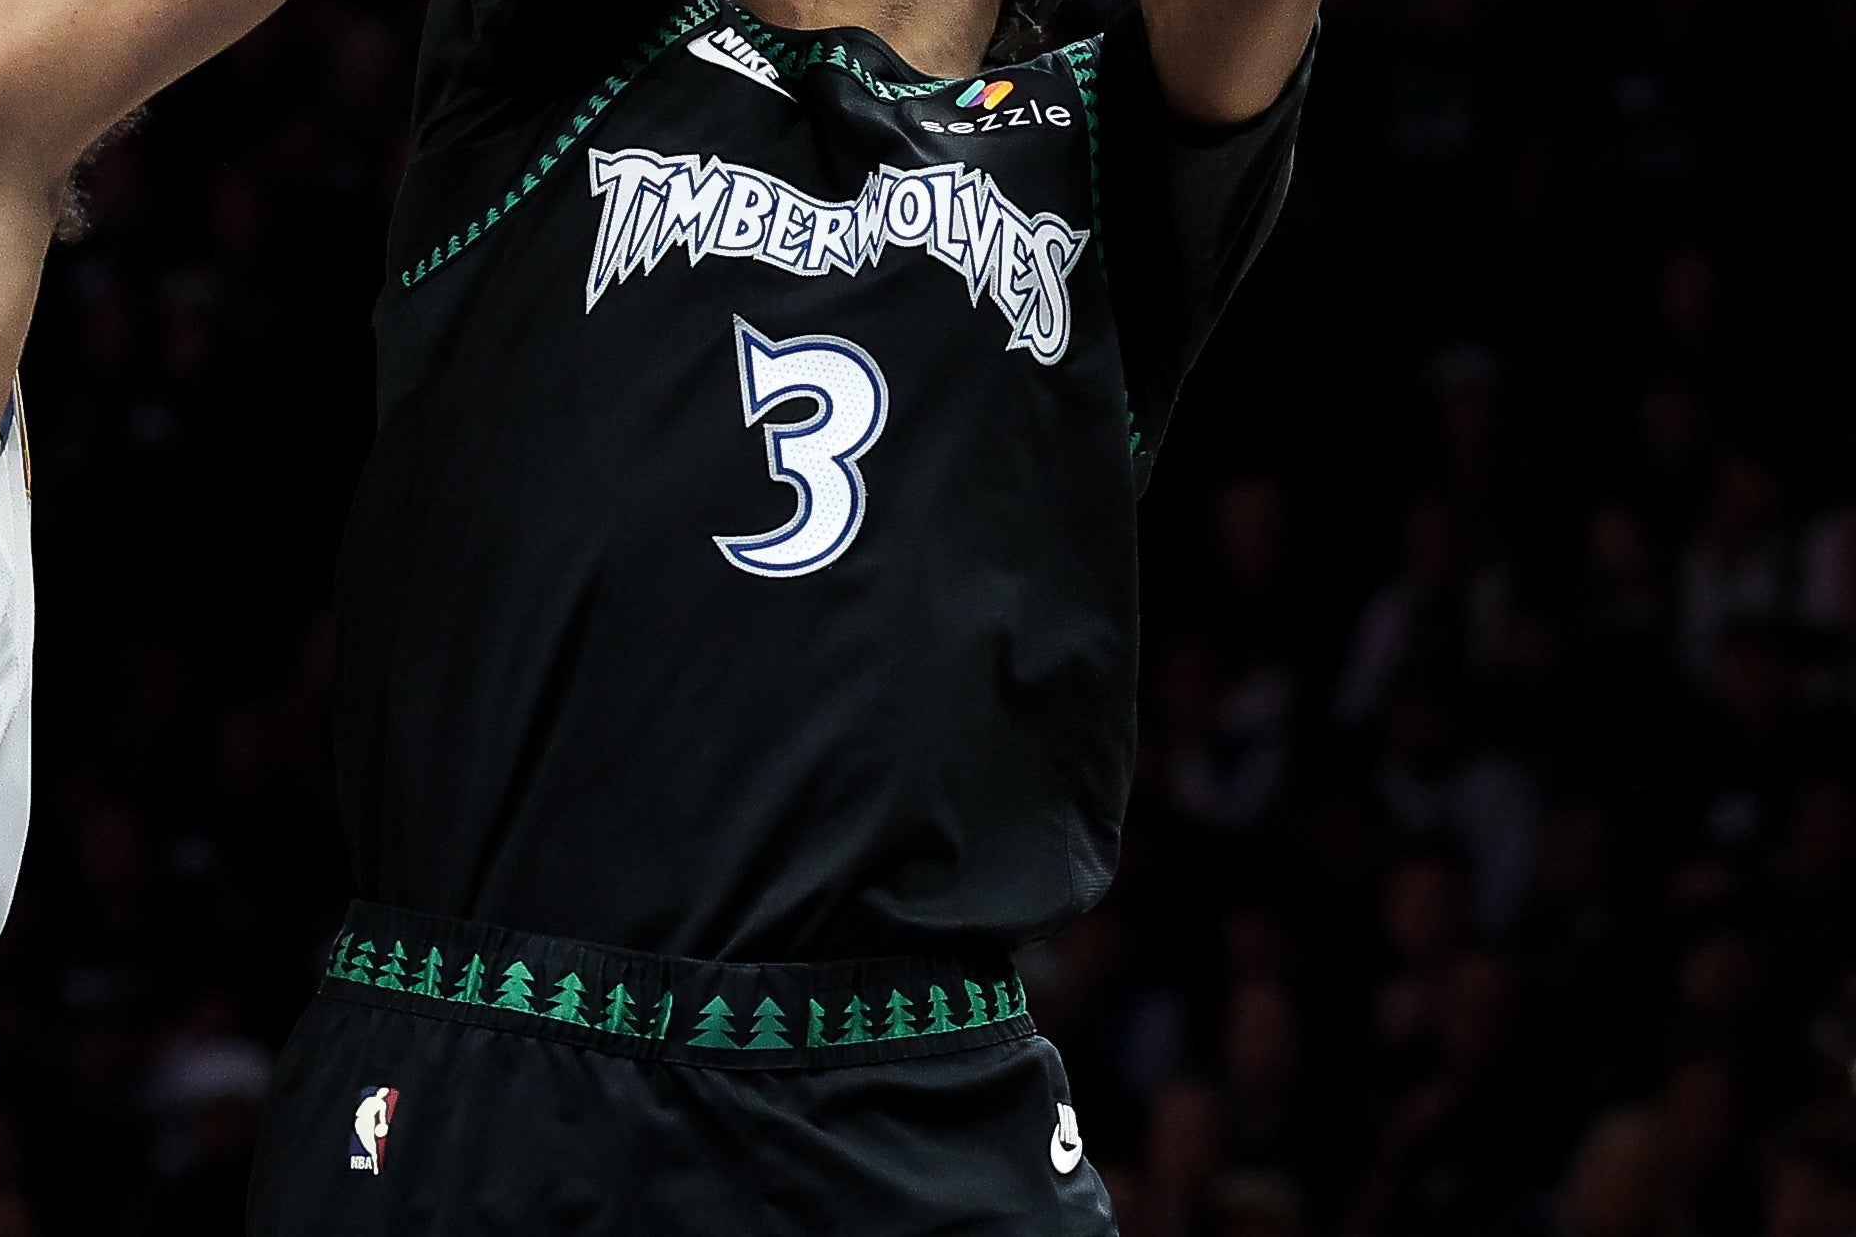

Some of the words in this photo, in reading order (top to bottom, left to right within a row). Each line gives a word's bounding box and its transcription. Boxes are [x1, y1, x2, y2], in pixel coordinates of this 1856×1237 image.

[711, 26, 780, 81] NIKE
[920, 99, 1072, 134] sezzle
[585, 148, 1090, 366] TIMBERWOLVES
[712, 313, 890, 578] 3
[350, 1155, 373, 1170] NBA
